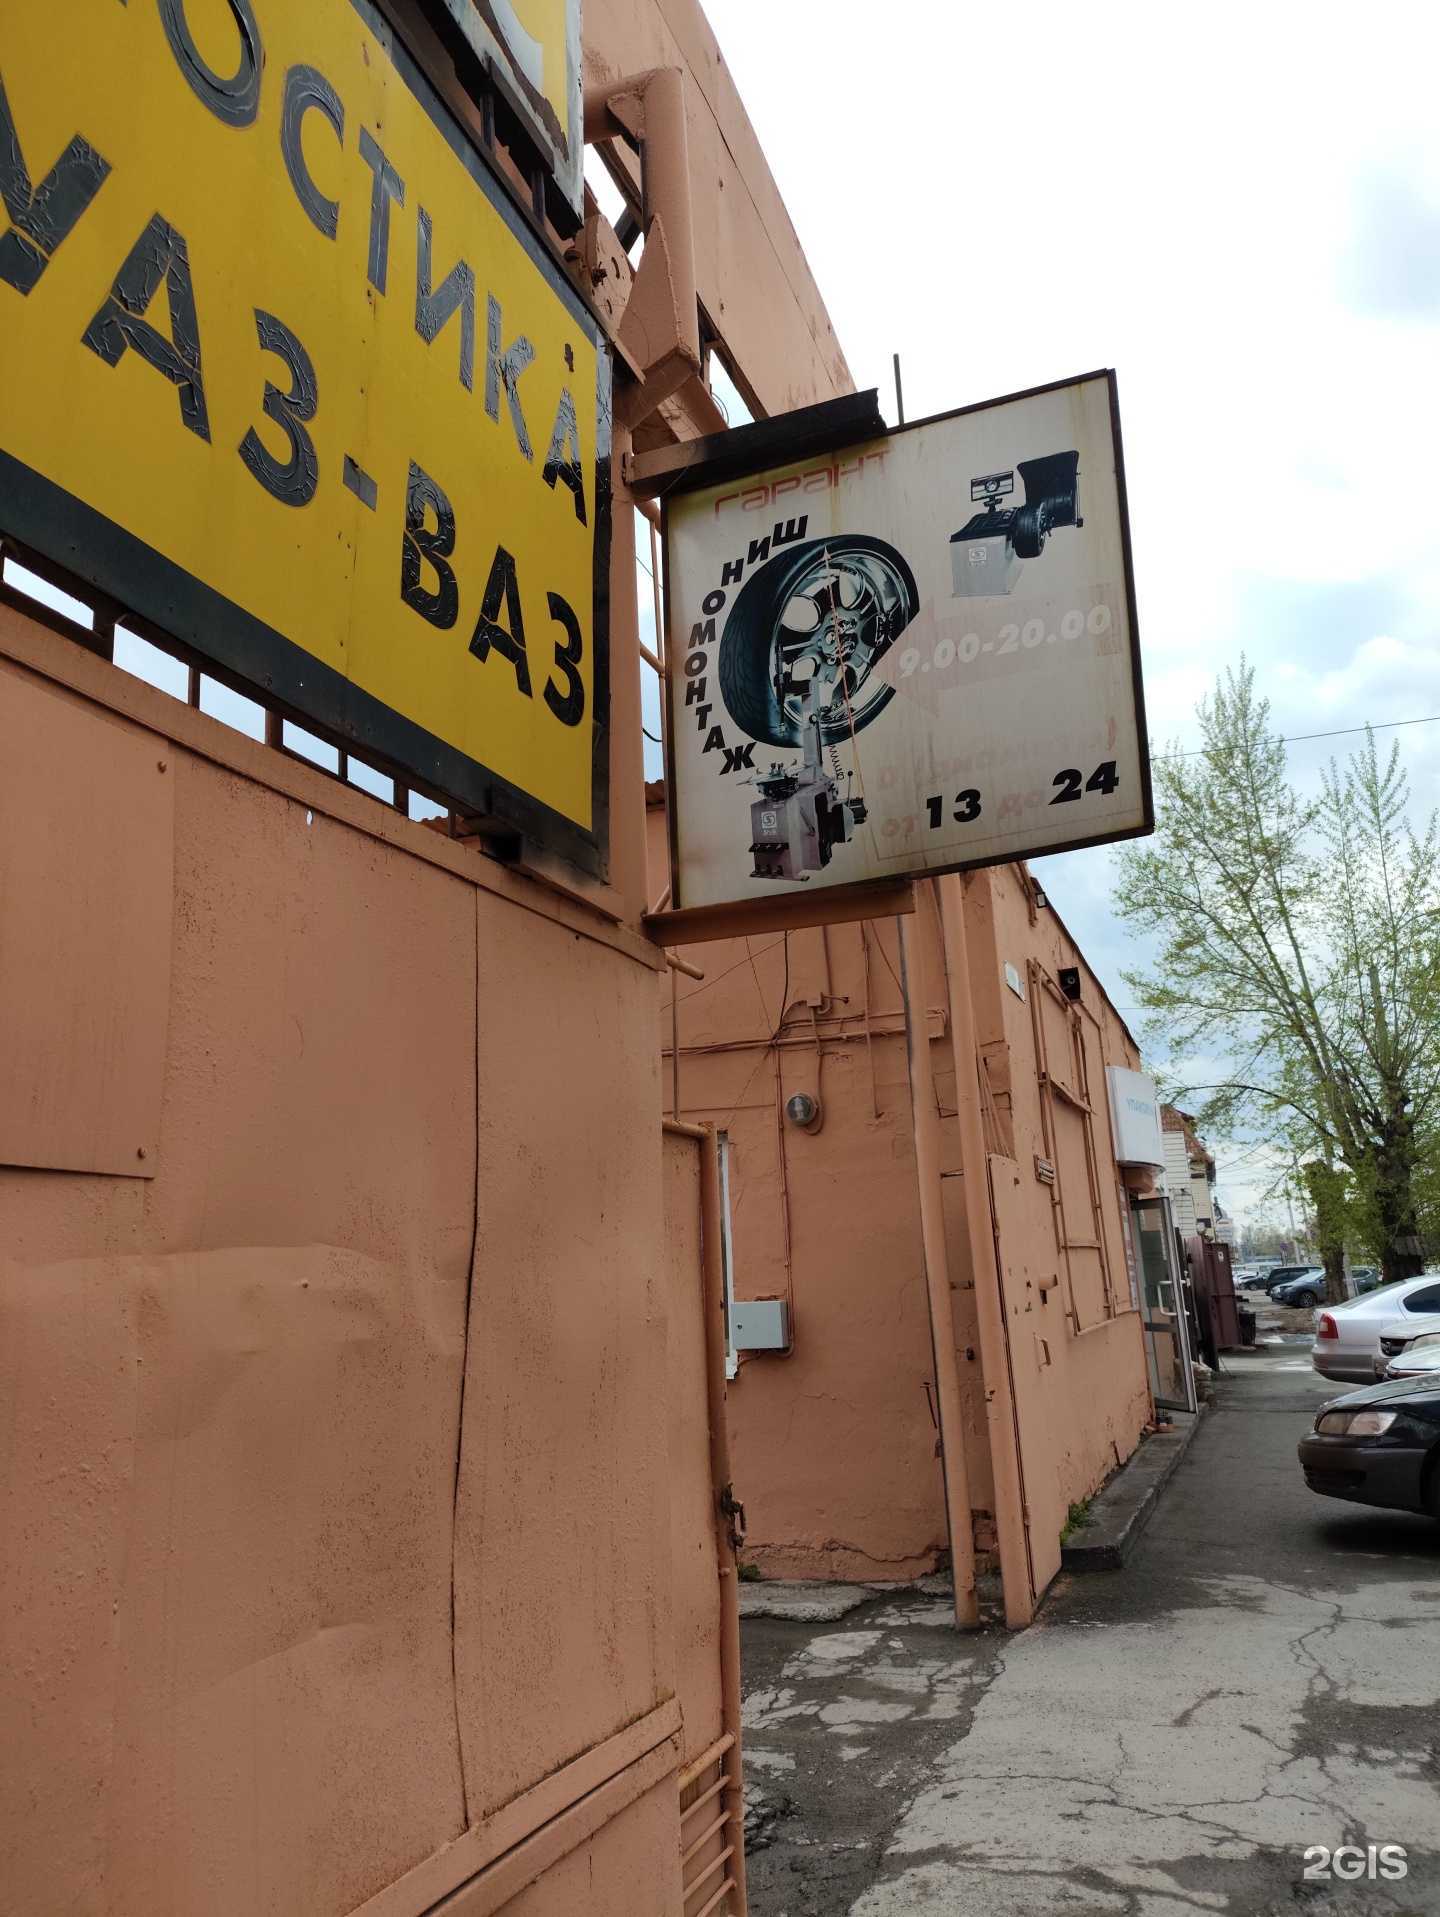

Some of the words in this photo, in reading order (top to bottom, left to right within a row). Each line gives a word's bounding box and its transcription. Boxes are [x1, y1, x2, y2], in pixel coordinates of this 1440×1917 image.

[118, 0, 588, 528] ОСТИКА
[899, 604, 1112, 679] 9.00-20.00
[925, 788, 983, 830] 13
[1047, 760, 1120, 806] 24
